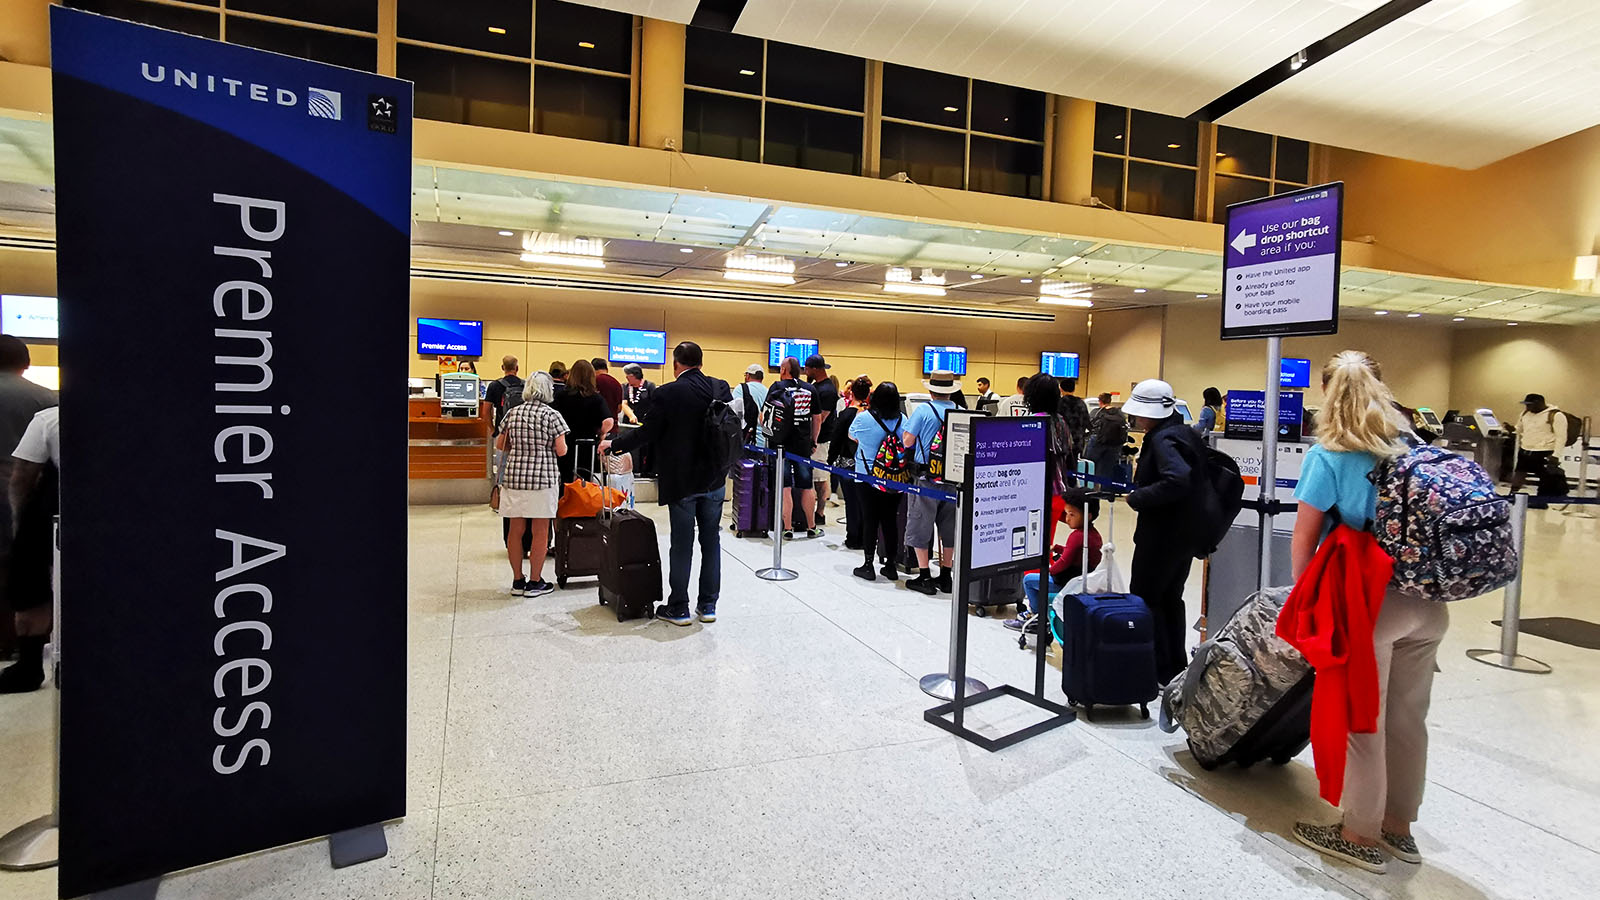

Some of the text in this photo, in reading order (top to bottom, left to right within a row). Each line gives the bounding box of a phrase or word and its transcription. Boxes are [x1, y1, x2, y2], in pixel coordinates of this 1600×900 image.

[141, 62, 298, 107] UNITED
[1295, 194, 1320, 203] UNITED
[1261, 216, 1321, 234] Use our bag
[1261, 225, 1330, 246] drop shortcut
[1260, 241, 1316, 256] area if you:
[1274, 267, 1296, 275] United
[1298, 265, 1311, 273] app
[1245, 282, 1269, 291] Already
[1270, 281, 1284, 289] paid
[1245, 289, 1275, 299] your bags
[1261, 300, 1276, 308] your
[1244, 307, 1288, 316] boarding pass
[998, 470, 1007, 478] bag
[212, 192, 291, 775] Premier Access
[975, 481, 998, 489] shortcut
[999, 479, 1011, 487] area
